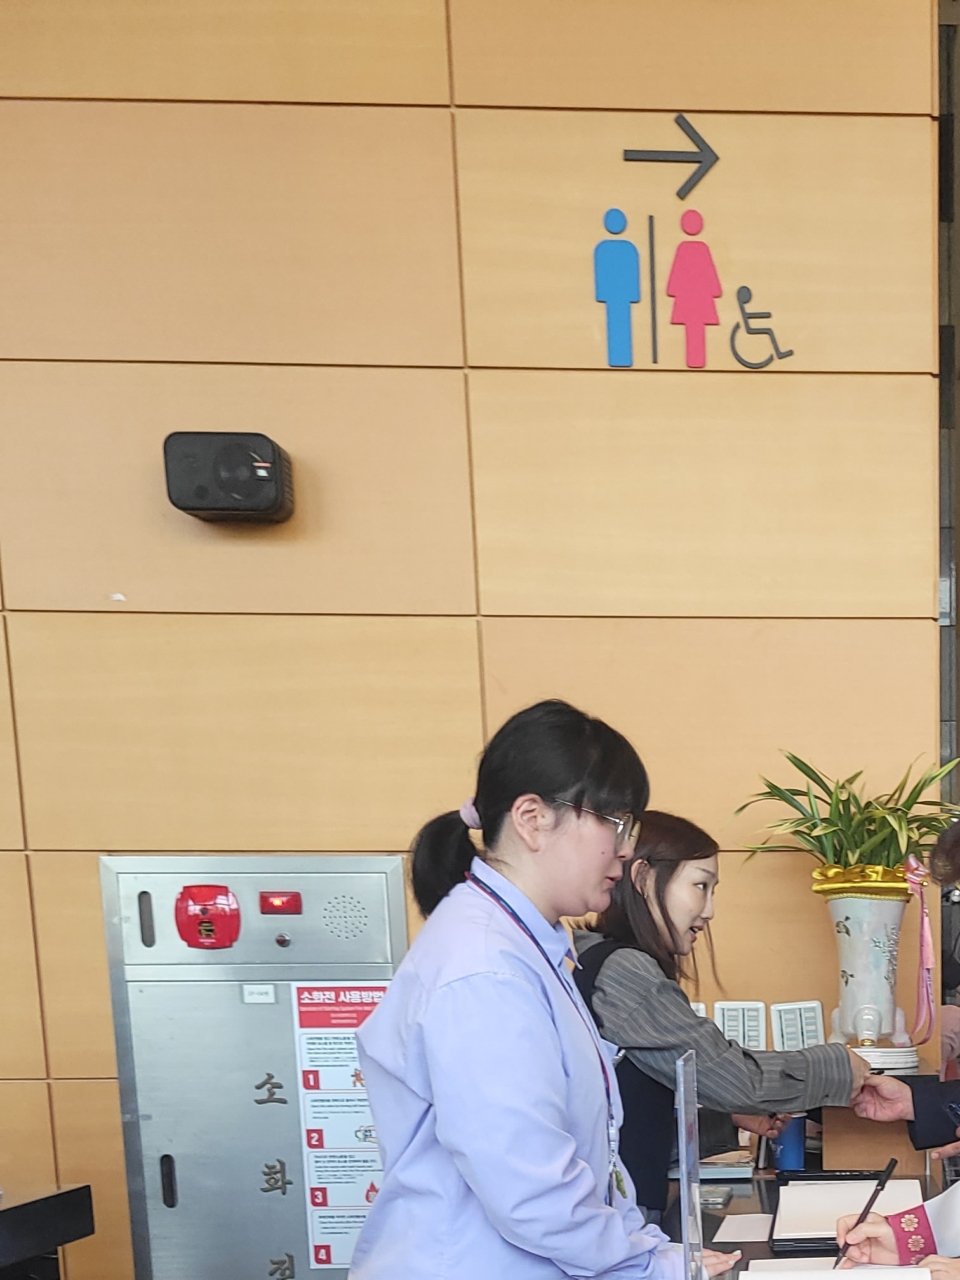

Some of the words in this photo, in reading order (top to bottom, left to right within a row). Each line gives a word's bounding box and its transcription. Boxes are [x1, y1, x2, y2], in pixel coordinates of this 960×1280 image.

[300, 990, 336, 1003] 소화전
[308, 1074, 315, 1087] 1
[310, 1132, 319, 1145] 2
[314, 1191, 323, 1203] 3
[318, 1249, 327, 1260] 4
